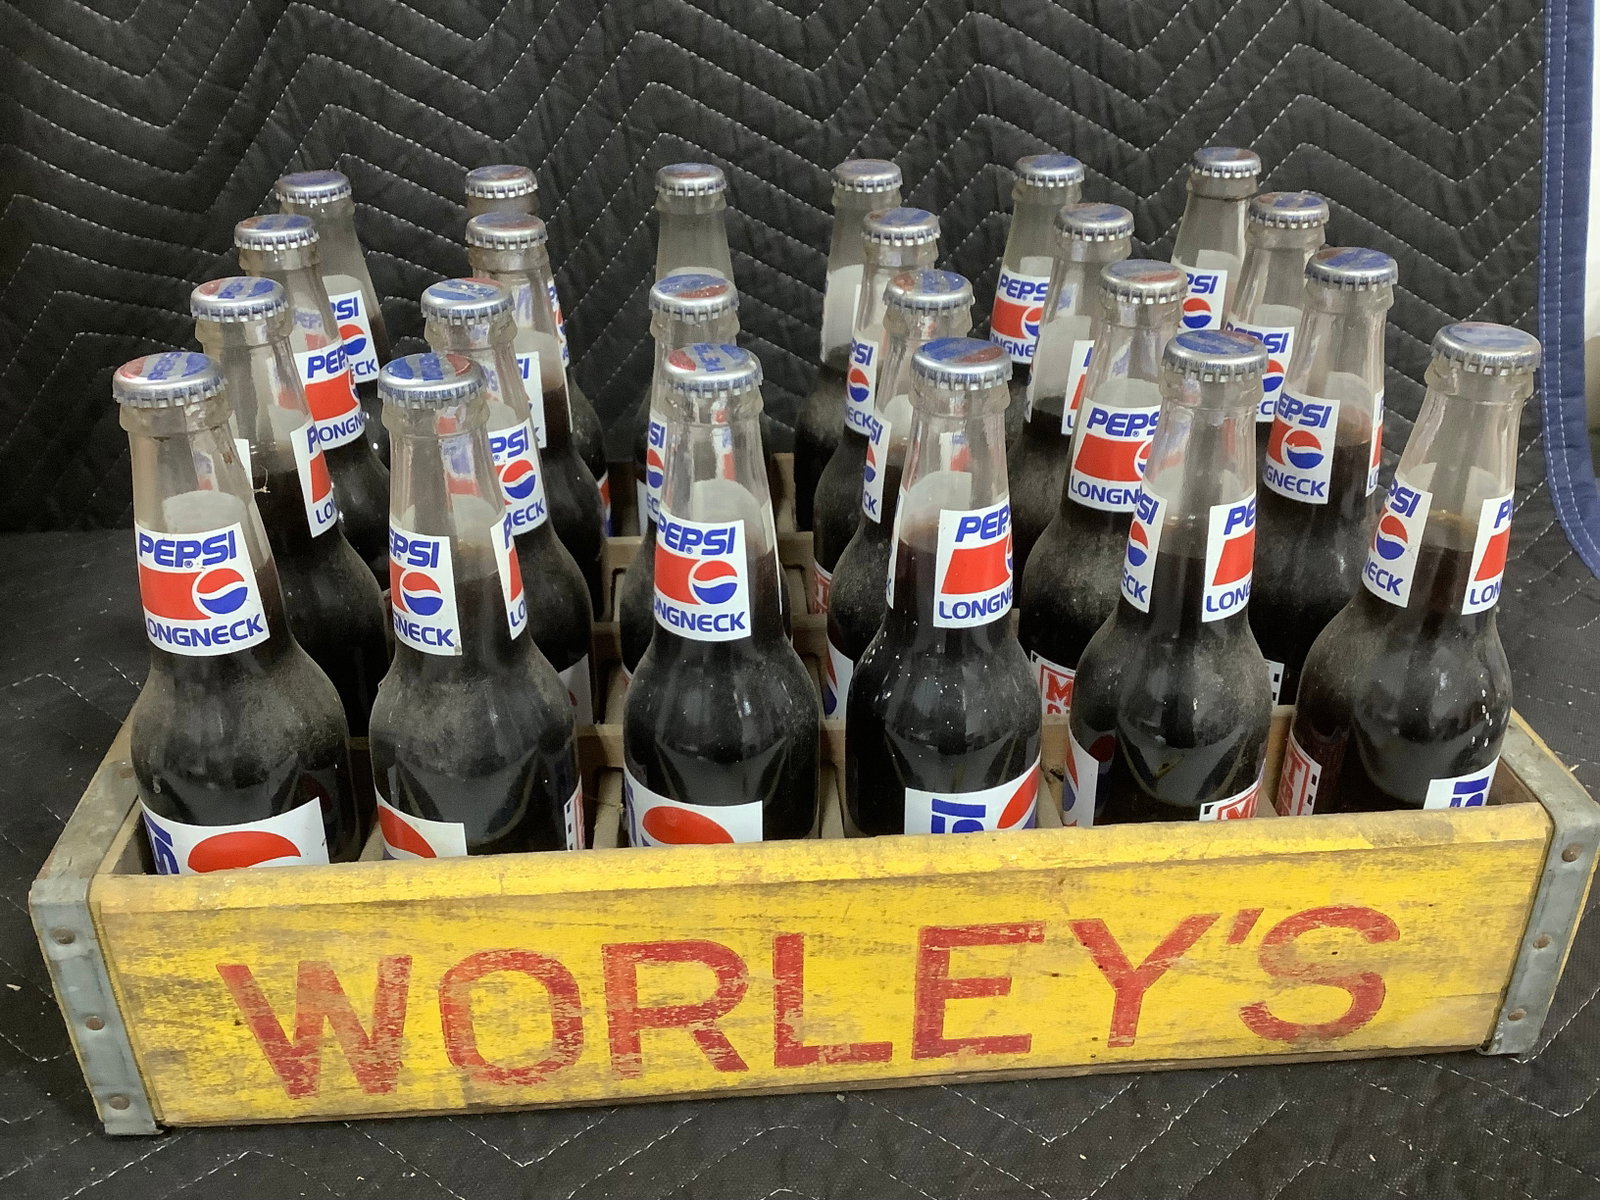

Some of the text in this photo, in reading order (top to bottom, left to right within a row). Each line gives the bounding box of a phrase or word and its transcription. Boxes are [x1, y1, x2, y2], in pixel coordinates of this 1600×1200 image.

[999, 273, 1049, 302] PEPS
[489, 426, 529, 458] PSI
[1071, 475, 1140, 504] LONGN
[955, 504, 1011, 542] PEP
[138, 530, 236, 568] PEPSI
[938, 584, 1012, 619] LONGN
[215, 903, 1401, 1099] WORLEY'S
